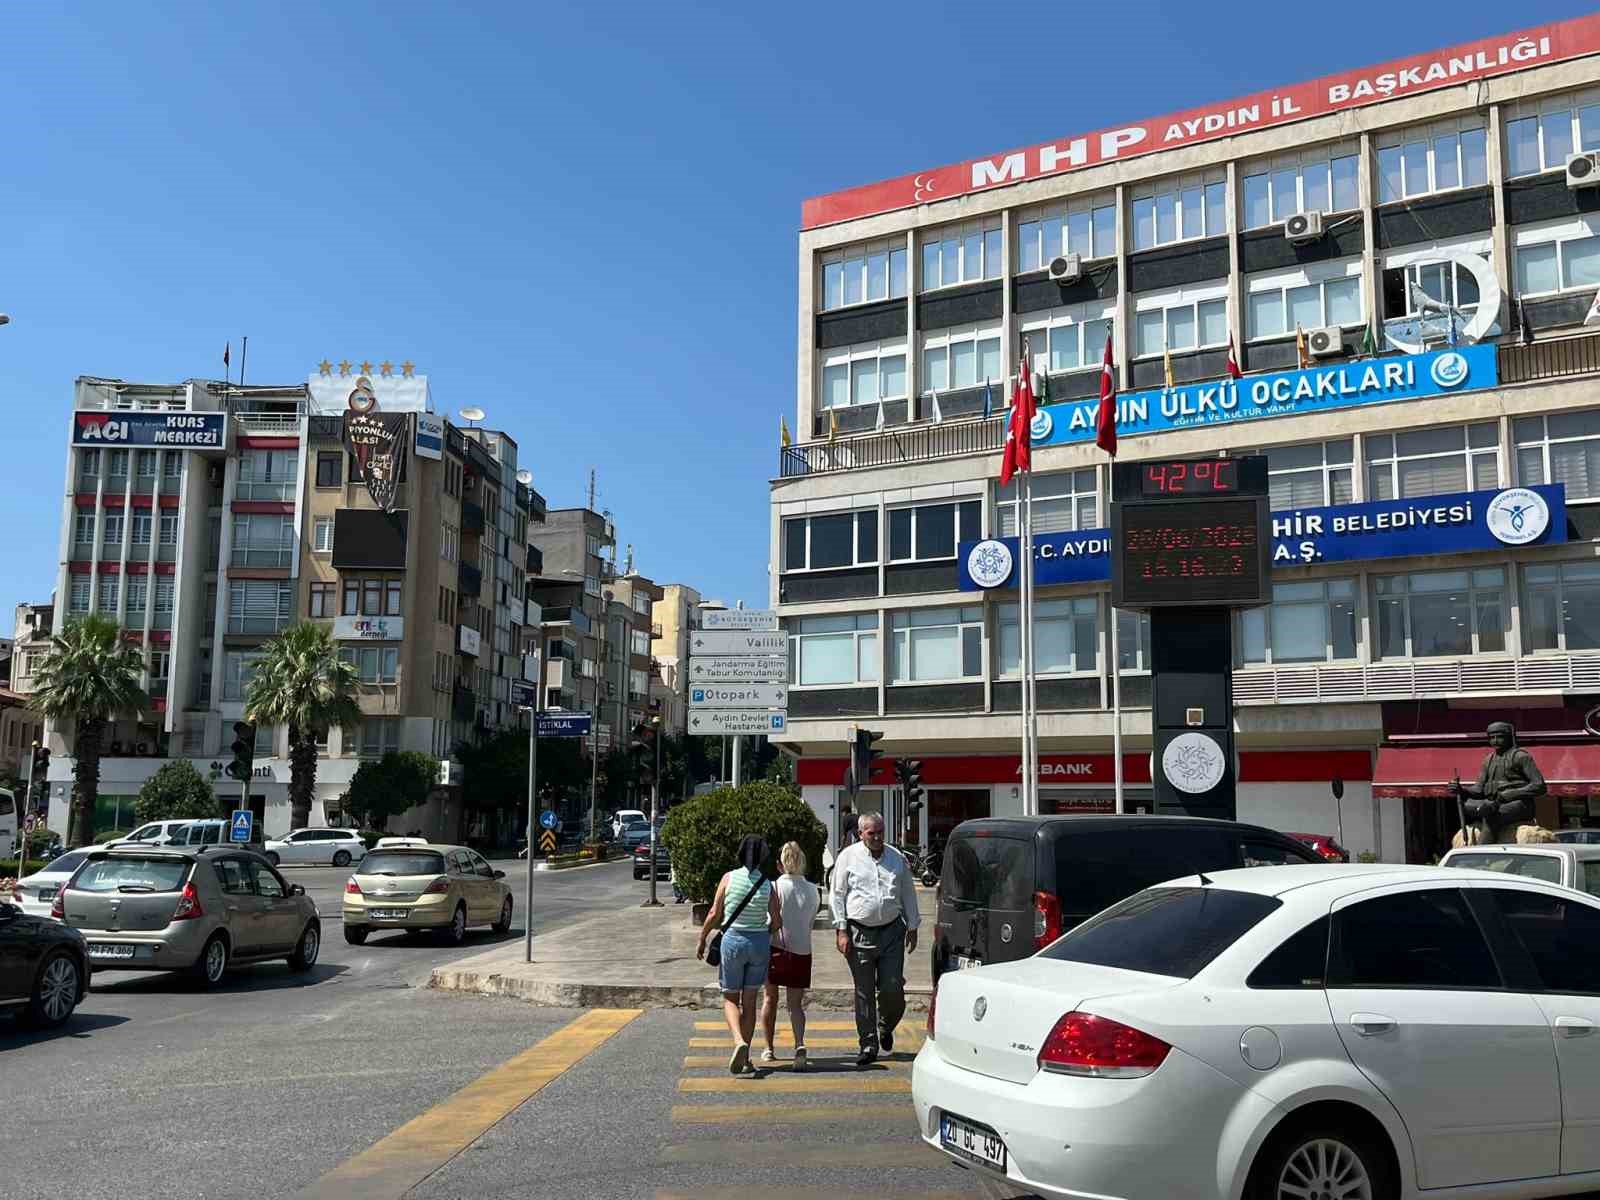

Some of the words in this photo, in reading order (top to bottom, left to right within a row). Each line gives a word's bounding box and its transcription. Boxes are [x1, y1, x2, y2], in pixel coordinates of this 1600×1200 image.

[971, 127, 1147, 188] MHP
[1163, 105, 1260, 142] AYDIN
[1271, 95, 1301, 117] İL
[1328, 37, 1551, 103] BAŞKANLIĞI
[1160, 380, 1238, 417] ÜLKÜ
[1251, 360, 1414, 405] OCAKLARI
[166, 416, 206, 429] KURS
[154, 428, 217, 444] MERKEZİ
[1333, 500, 1472, 533] BELEDİYESİ
[1062, 538, 1112, 557] AYDI
[1273, 541, 1322, 563] A.Ş.
[746, 637, 785, 648] Valilik
[711, 659, 756, 668] Jandarma
[706, 669, 730, 677] Tabur
[705, 689, 760, 701] Otopark
[711, 714, 739, 723] Aydın
[724, 722, 769, 730] Hastanesi
[946, 1118, 958, 1142] 20
[964, 1125, 976, 1151] GC
[983, 1133, 1003, 1161] 497
